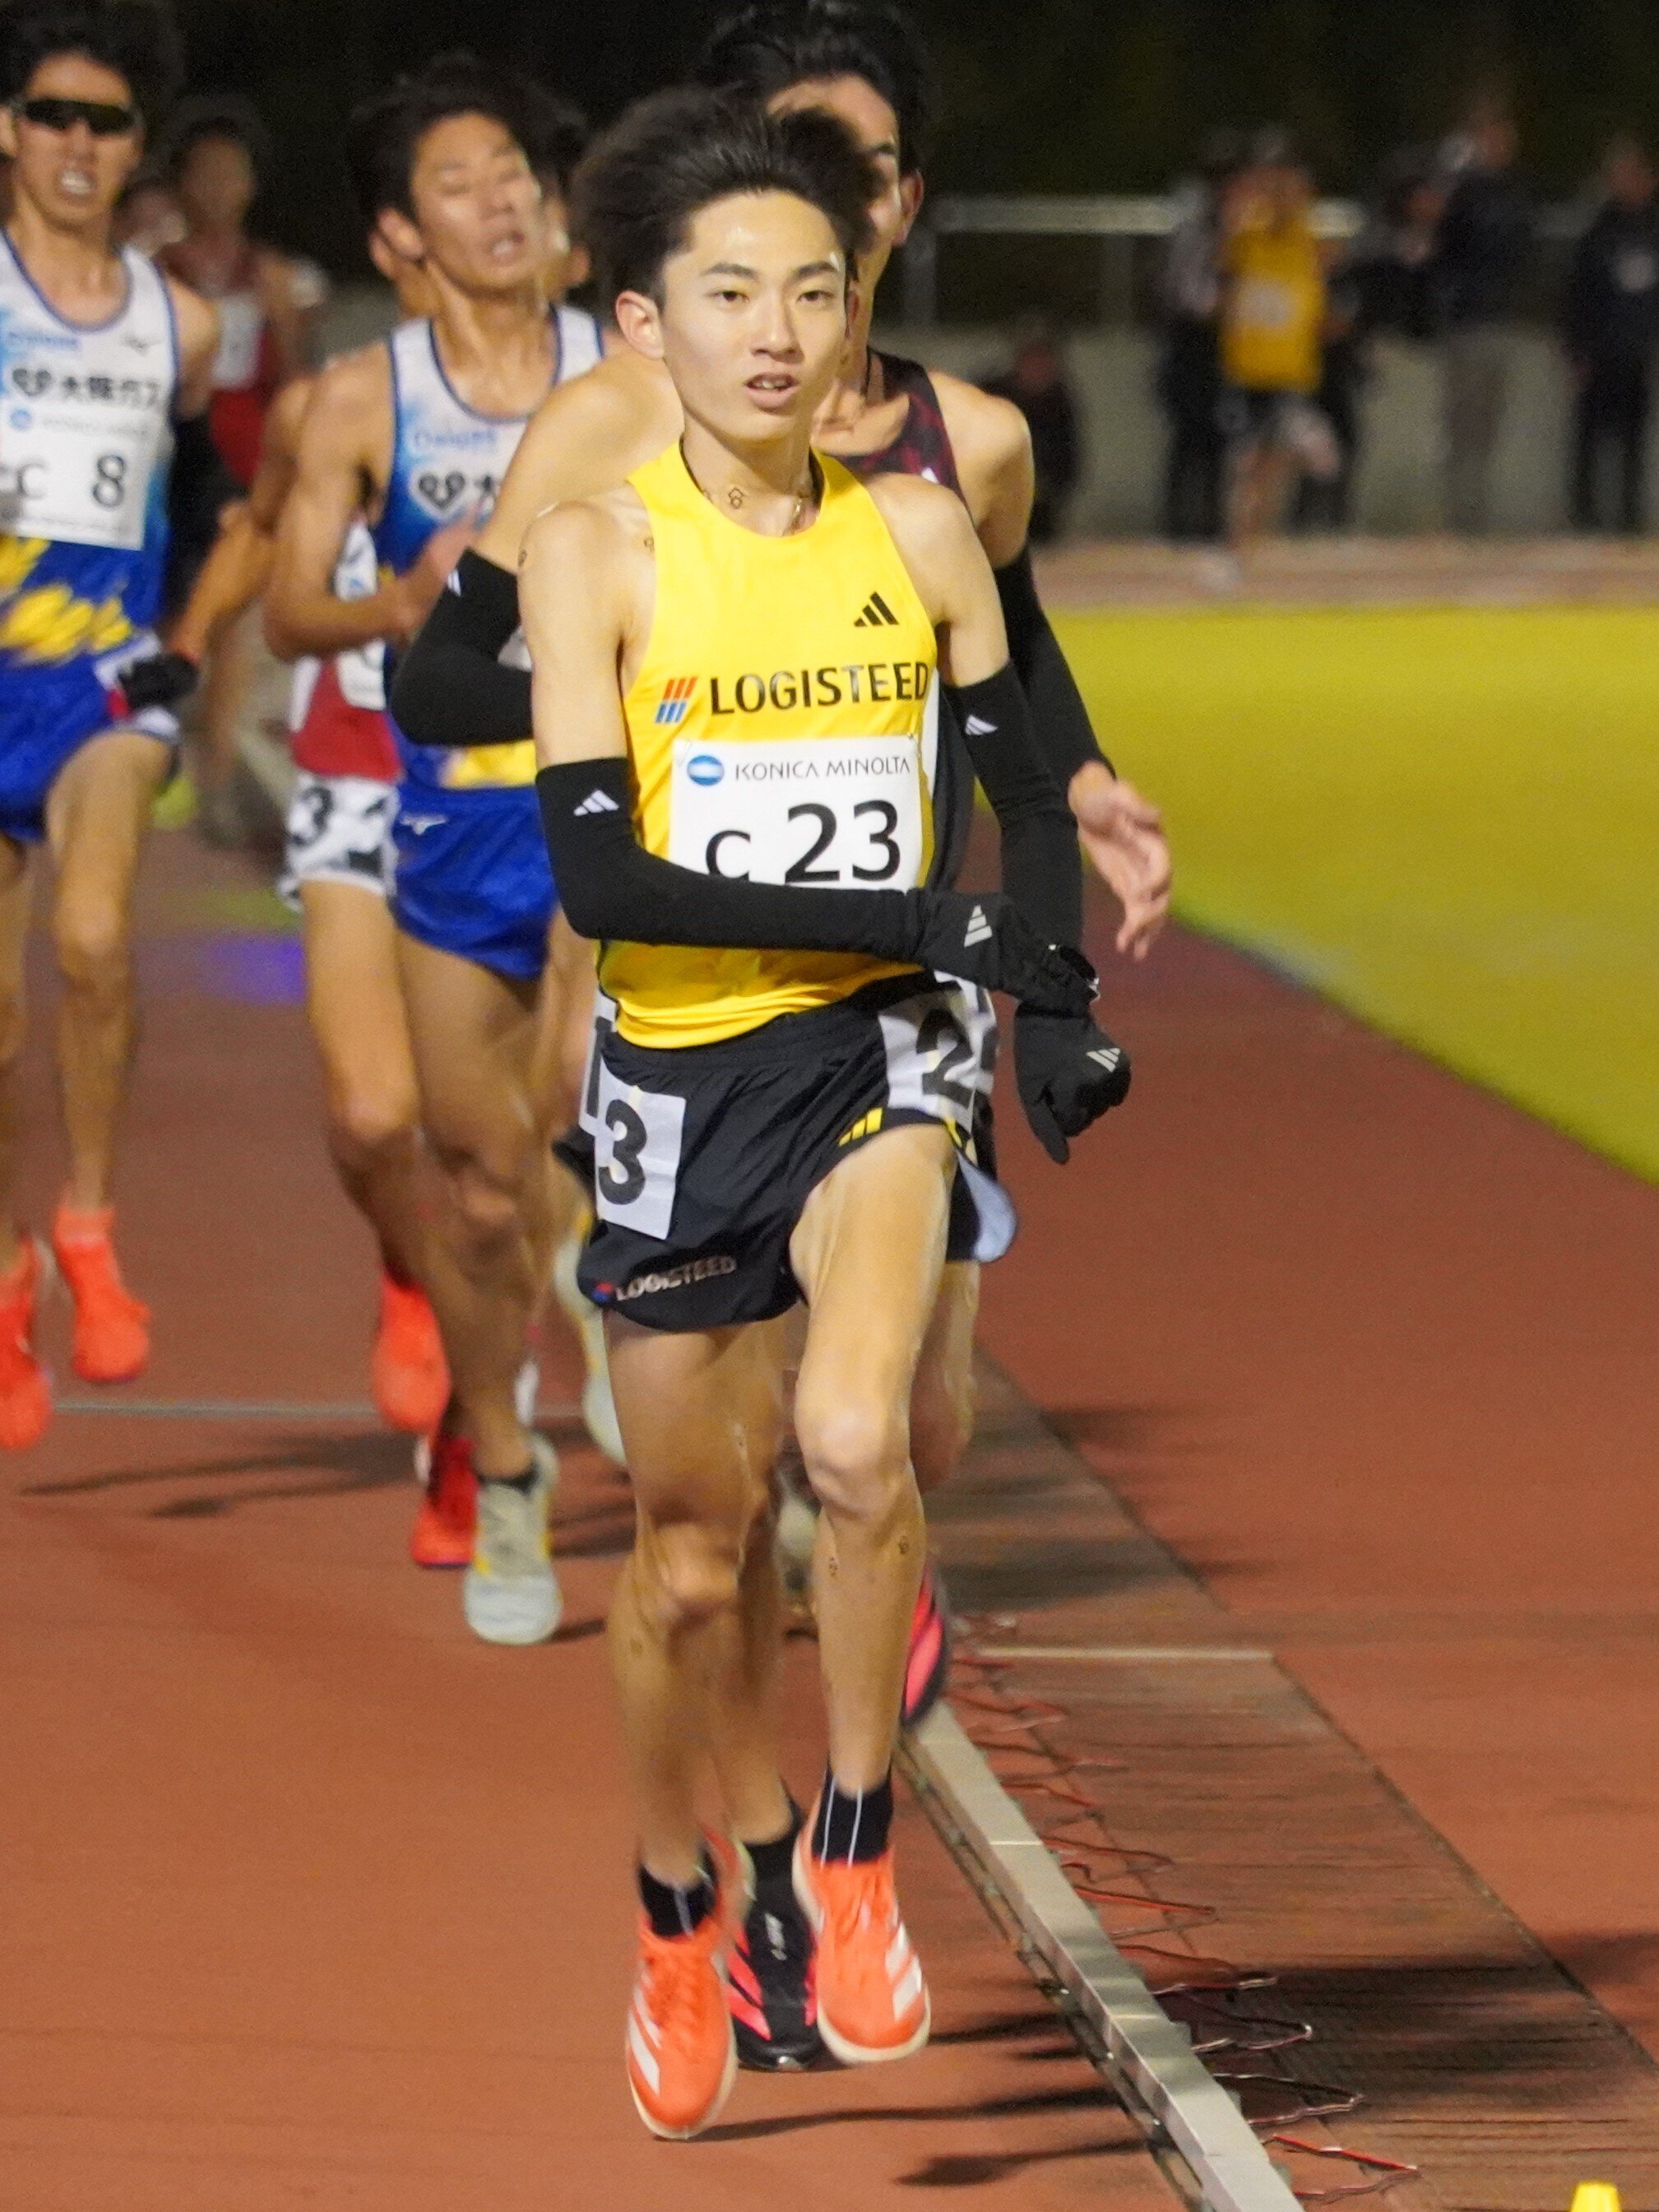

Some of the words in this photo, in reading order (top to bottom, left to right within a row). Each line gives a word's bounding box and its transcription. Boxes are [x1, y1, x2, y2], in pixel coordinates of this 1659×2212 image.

[92, 454, 125, 508] 8
[710, 661, 929, 716] LOGISTEED
[735, 759, 820, 781] KONICA
[826, 756, 911, 777] MINOLTA
[784, 799, 901, 884] 23
[916, 1009, 976, 1111] 2
[598, 1099, 648, 1205] 3
[616, 1255, 739, 1302] LOGISTEED
